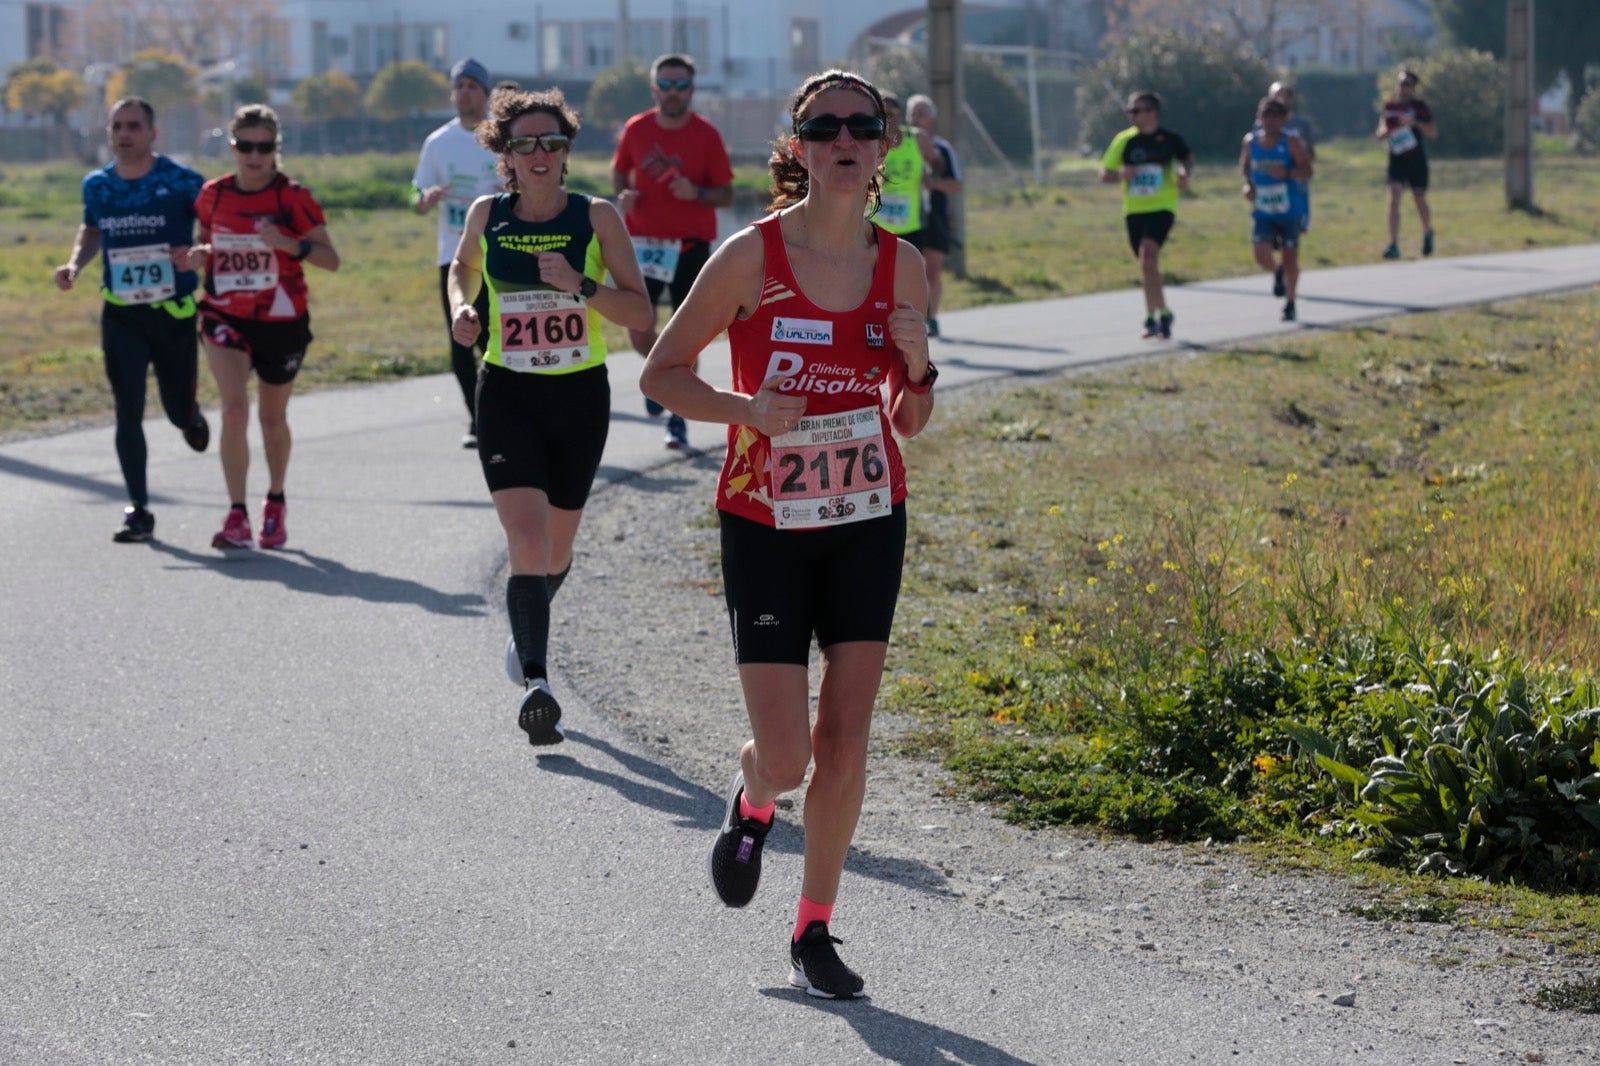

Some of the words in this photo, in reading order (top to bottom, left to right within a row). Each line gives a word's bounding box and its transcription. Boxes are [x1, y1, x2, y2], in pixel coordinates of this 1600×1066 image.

[497, 235, 571, 244] ATLETISMO
[217, 252, 271, 272] 2087
[121, 263, 163, 286] 479
[506, 313, 584, 346] 2160
[808, 362, 856, 377] Clínicas
[800, 420, 820, 432] GRAN
[822, 415, 848, 429] PREMIO
[848, 414, 856, 426] DE
[856, 410, 875, 423] FONDO
[780, 443, 883, 493] 2176
